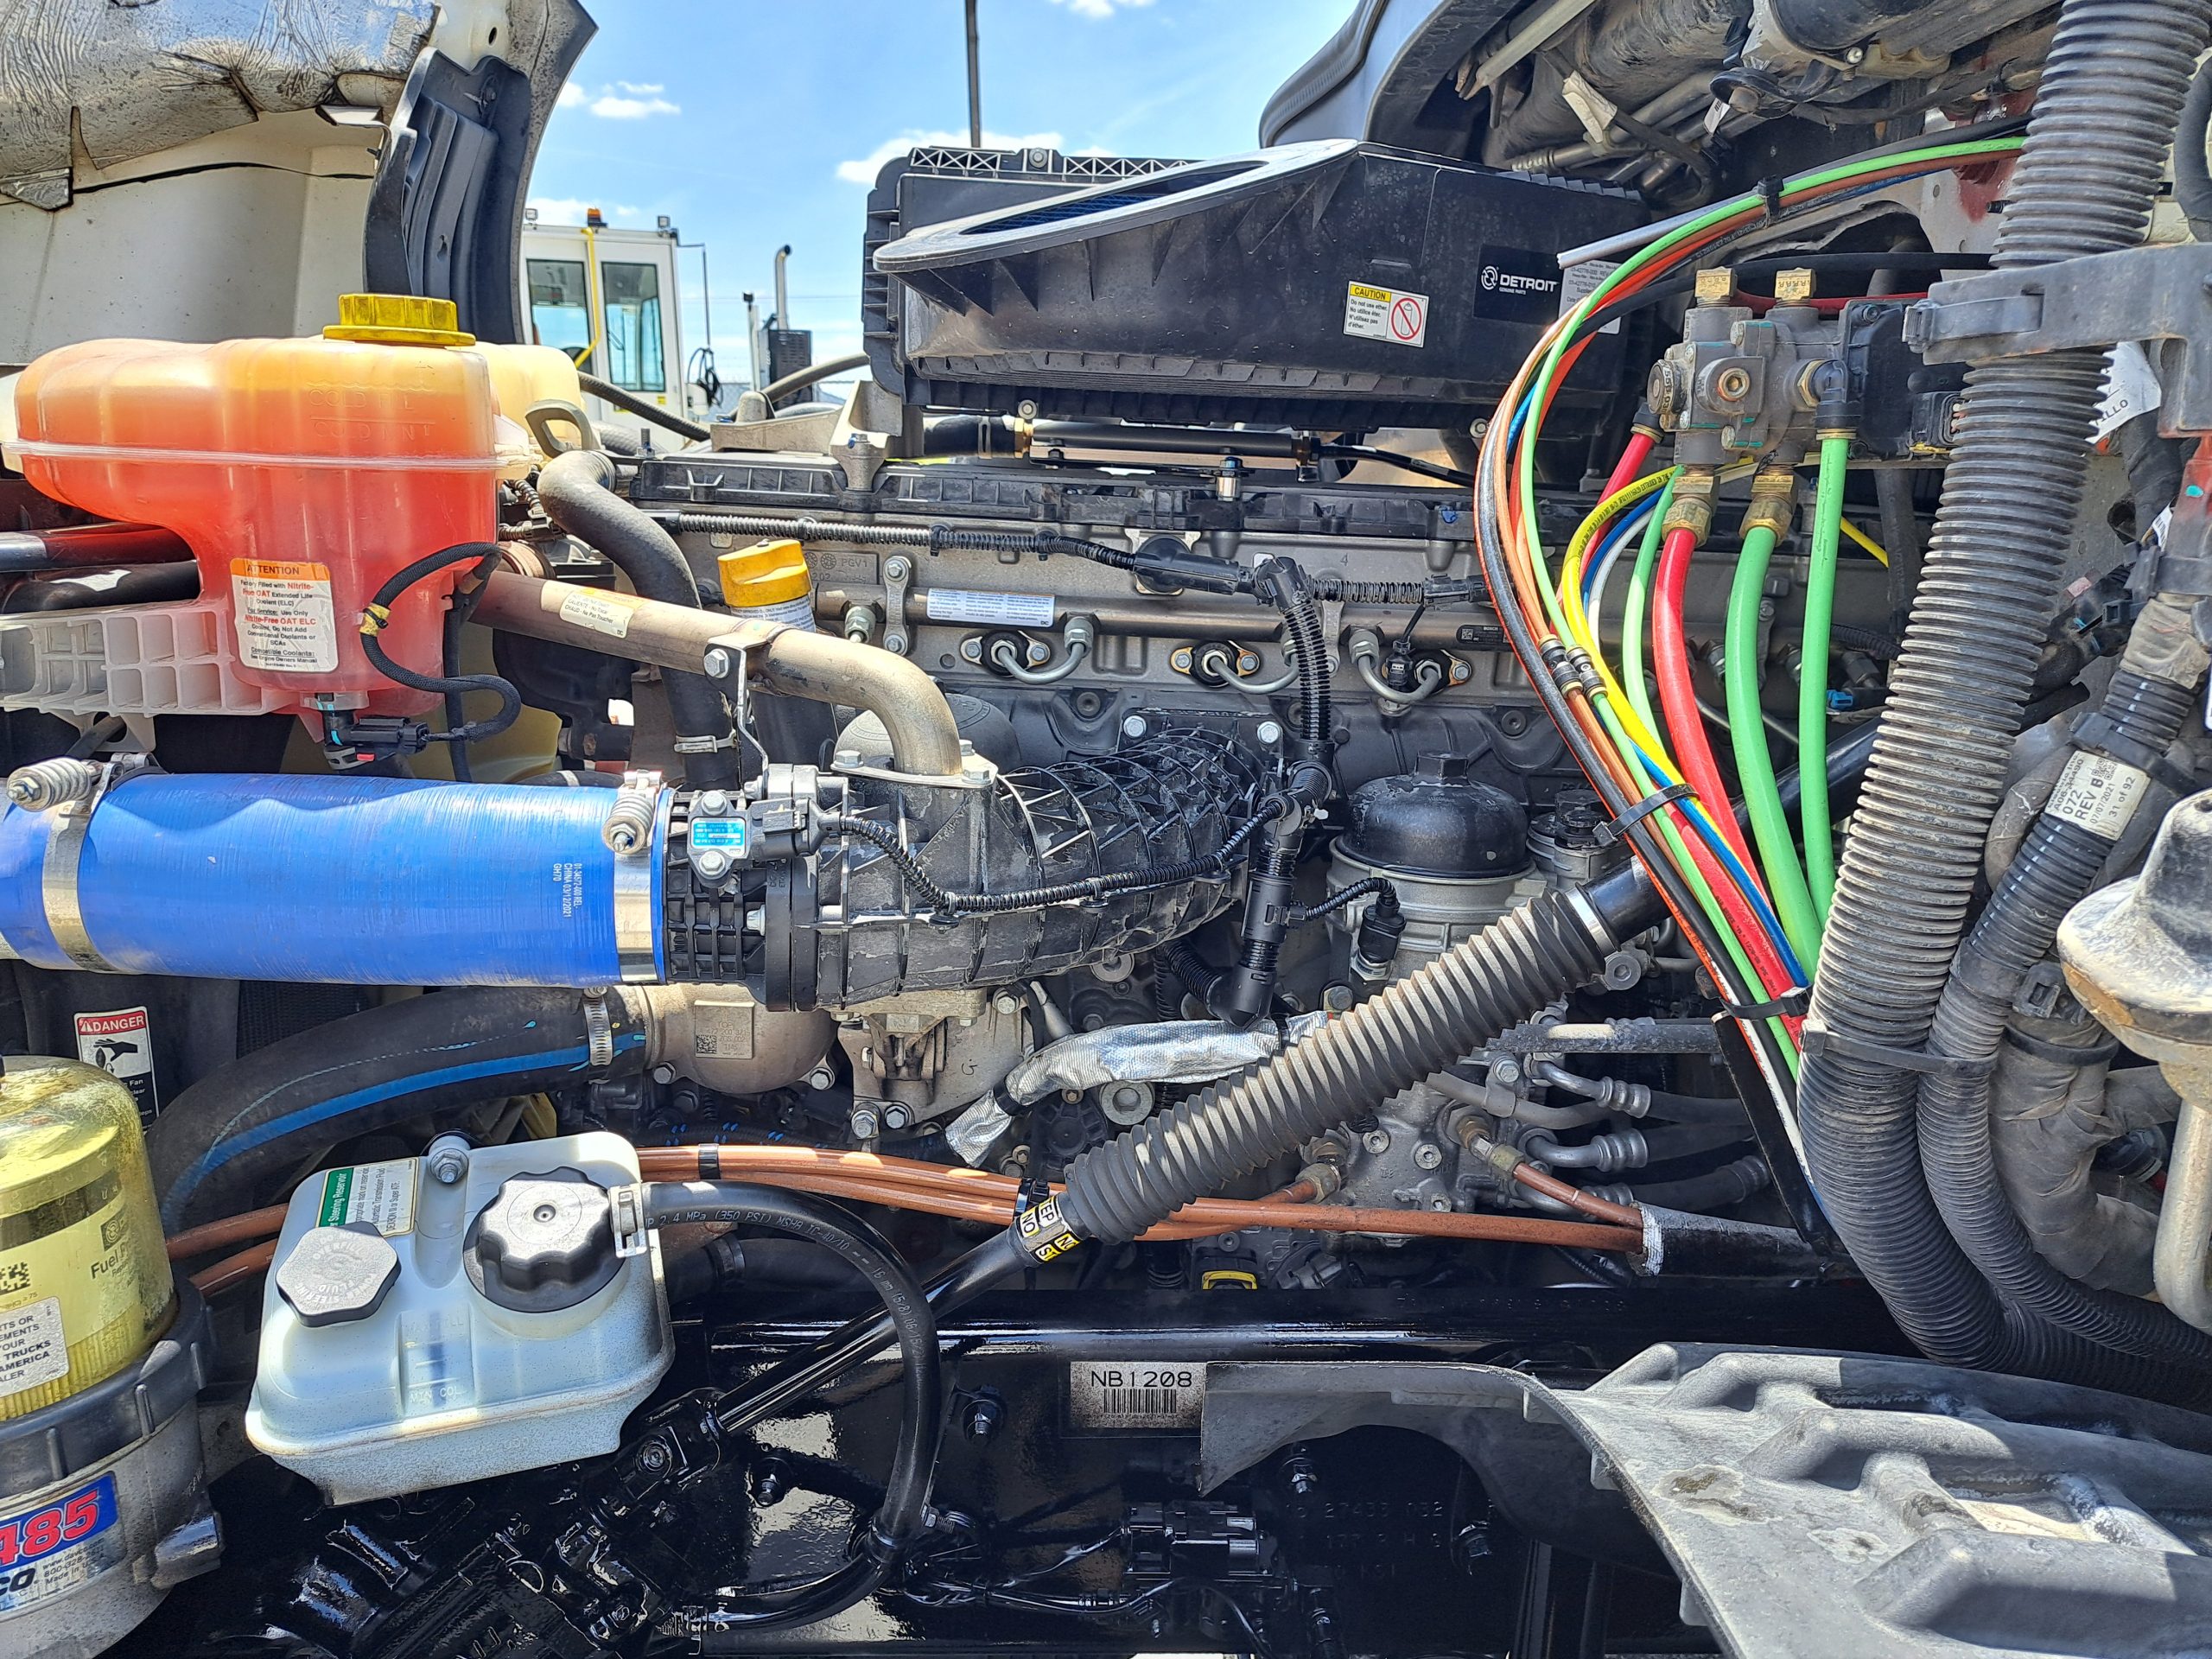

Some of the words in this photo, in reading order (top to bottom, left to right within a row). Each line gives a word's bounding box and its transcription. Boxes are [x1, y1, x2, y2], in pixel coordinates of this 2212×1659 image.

[1500, 274, 1557, 292] DETROIT
[1354, 287, 1386, 300] CAUTION
[247, 564, 300, 575] ATTENTION
[2063, 790, 2082, 815] 072
[2074, 791, 2097, 820] REV
[2090, 779, 2104, 789] B
[2089, 783, 2115, 824] 07/07/2021
[2108, 805, 2120, 817] 31
[2118, 791, 2128, 803] of
[2123, 777, 2136, 791] 92
[553, 863, 562, 881] GH70
[563, 863, 572, 883] CHINA
[92, 1015, 145, 1032] DANGER
[333, 1173, 347, 1198] Reservoir
[328, 1198, 346, 1222] Steering
[686, 1211, 706, 1221] MPa
[715, 1210, 741, 1220] (350
[744, 1212, 772, 1223] PSI)
[1021, 1212, 1035, 1233] NO
[91, 1249, 118, 1279] Fuel
[19, 1315, 34, 1325] OR
[0, 1338, 26, 1351] OUR
[3, 1340, 51, 1361] TRUCKS
[0, 1351, 50, 1372] AMERICA
[1091, 1370, 1192, 1388] NB1208
[0, 1490, 99, 1565] 485
[46, 1572, 68, 1584] Made
